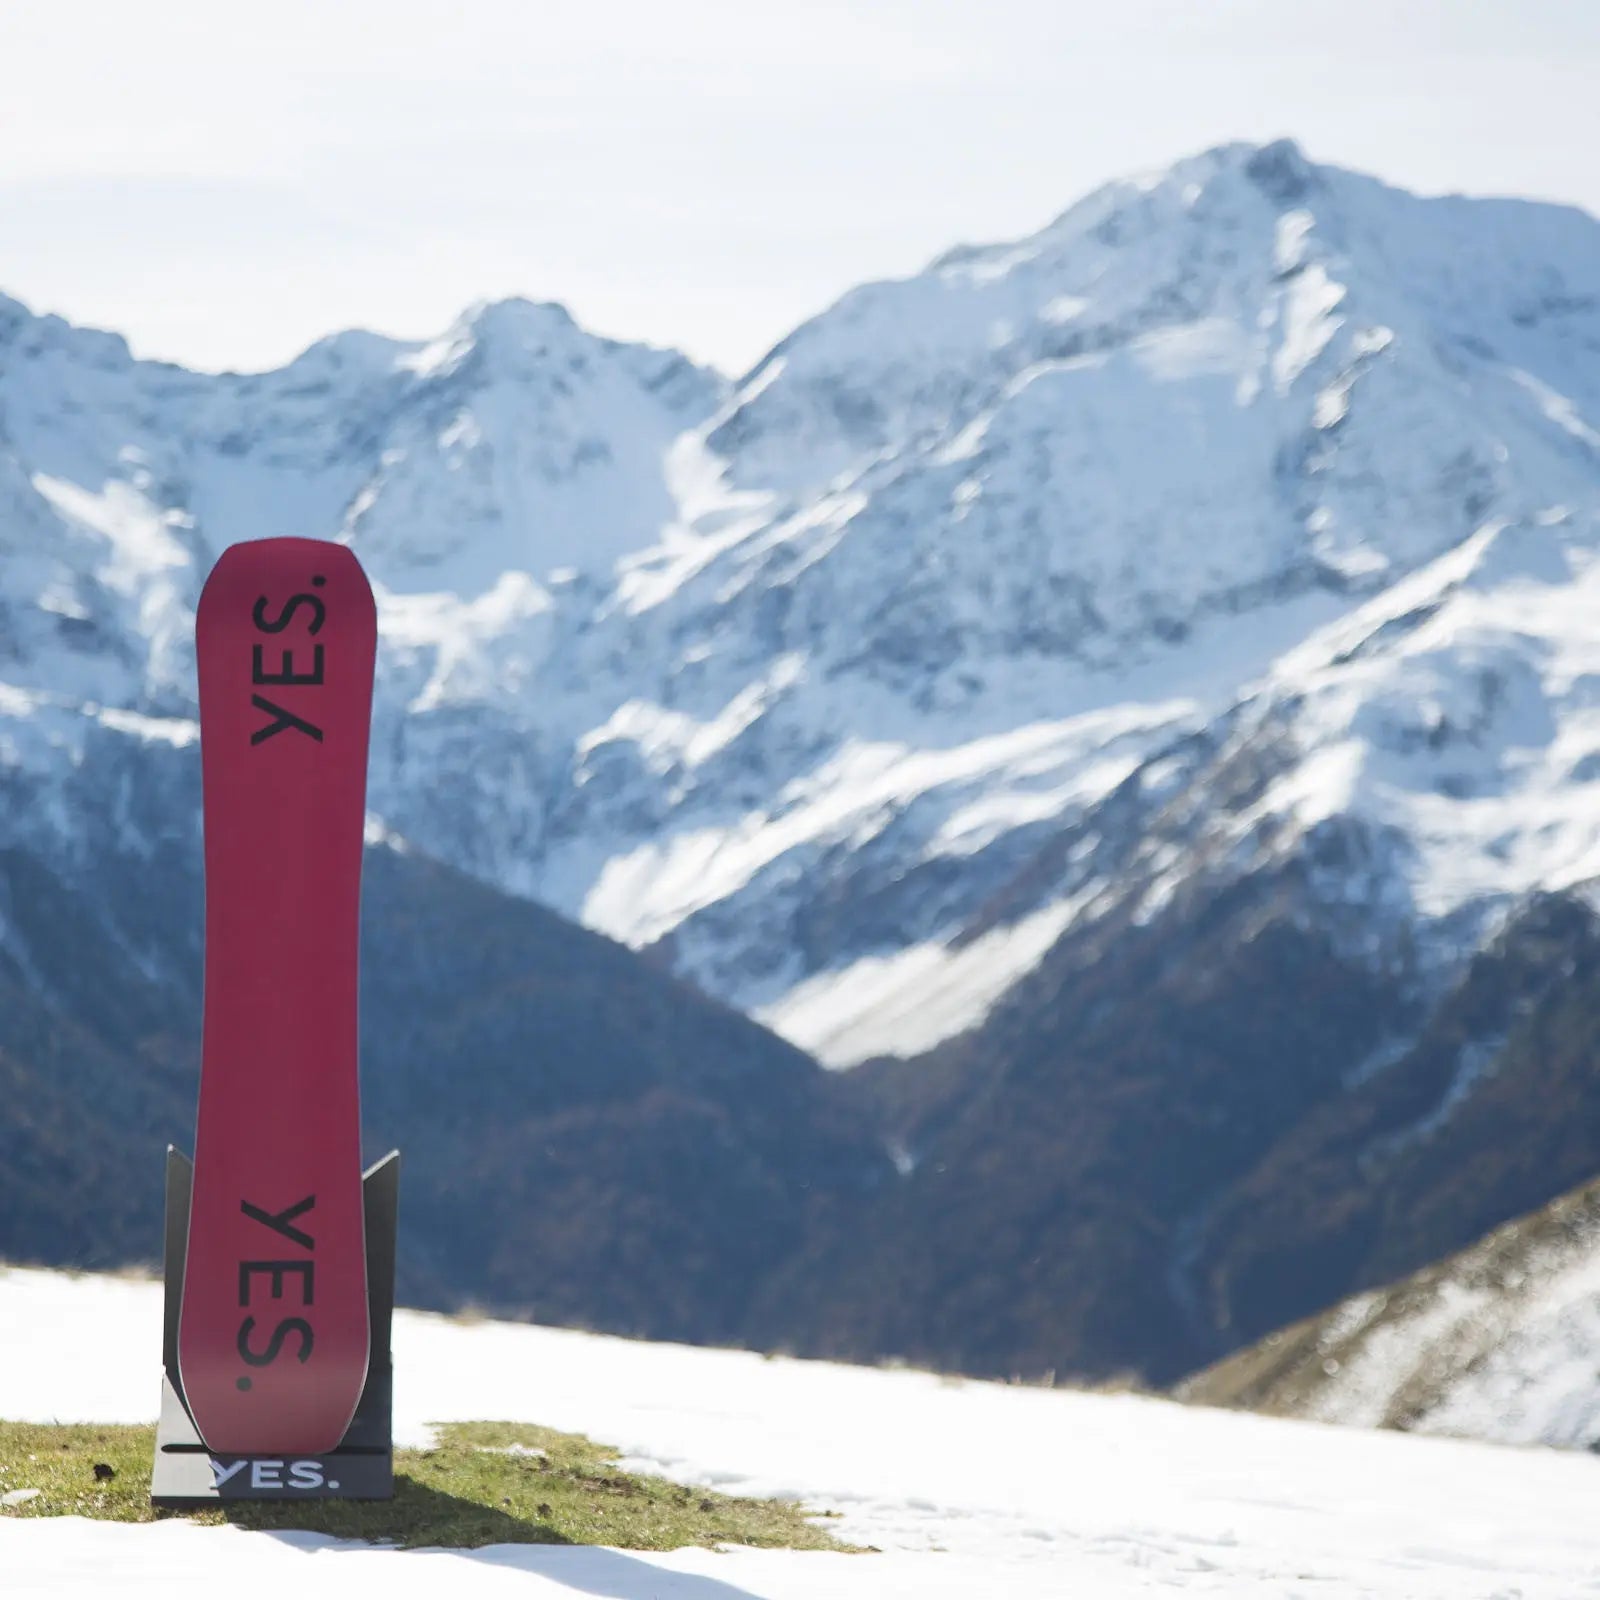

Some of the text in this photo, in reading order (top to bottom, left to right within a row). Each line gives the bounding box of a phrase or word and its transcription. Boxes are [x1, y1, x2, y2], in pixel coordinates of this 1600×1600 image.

[251, 574, 327, 746] YES.
[236, 1194, 316, 1392] YES.
[208, 1459, 340, 1490] YES.
